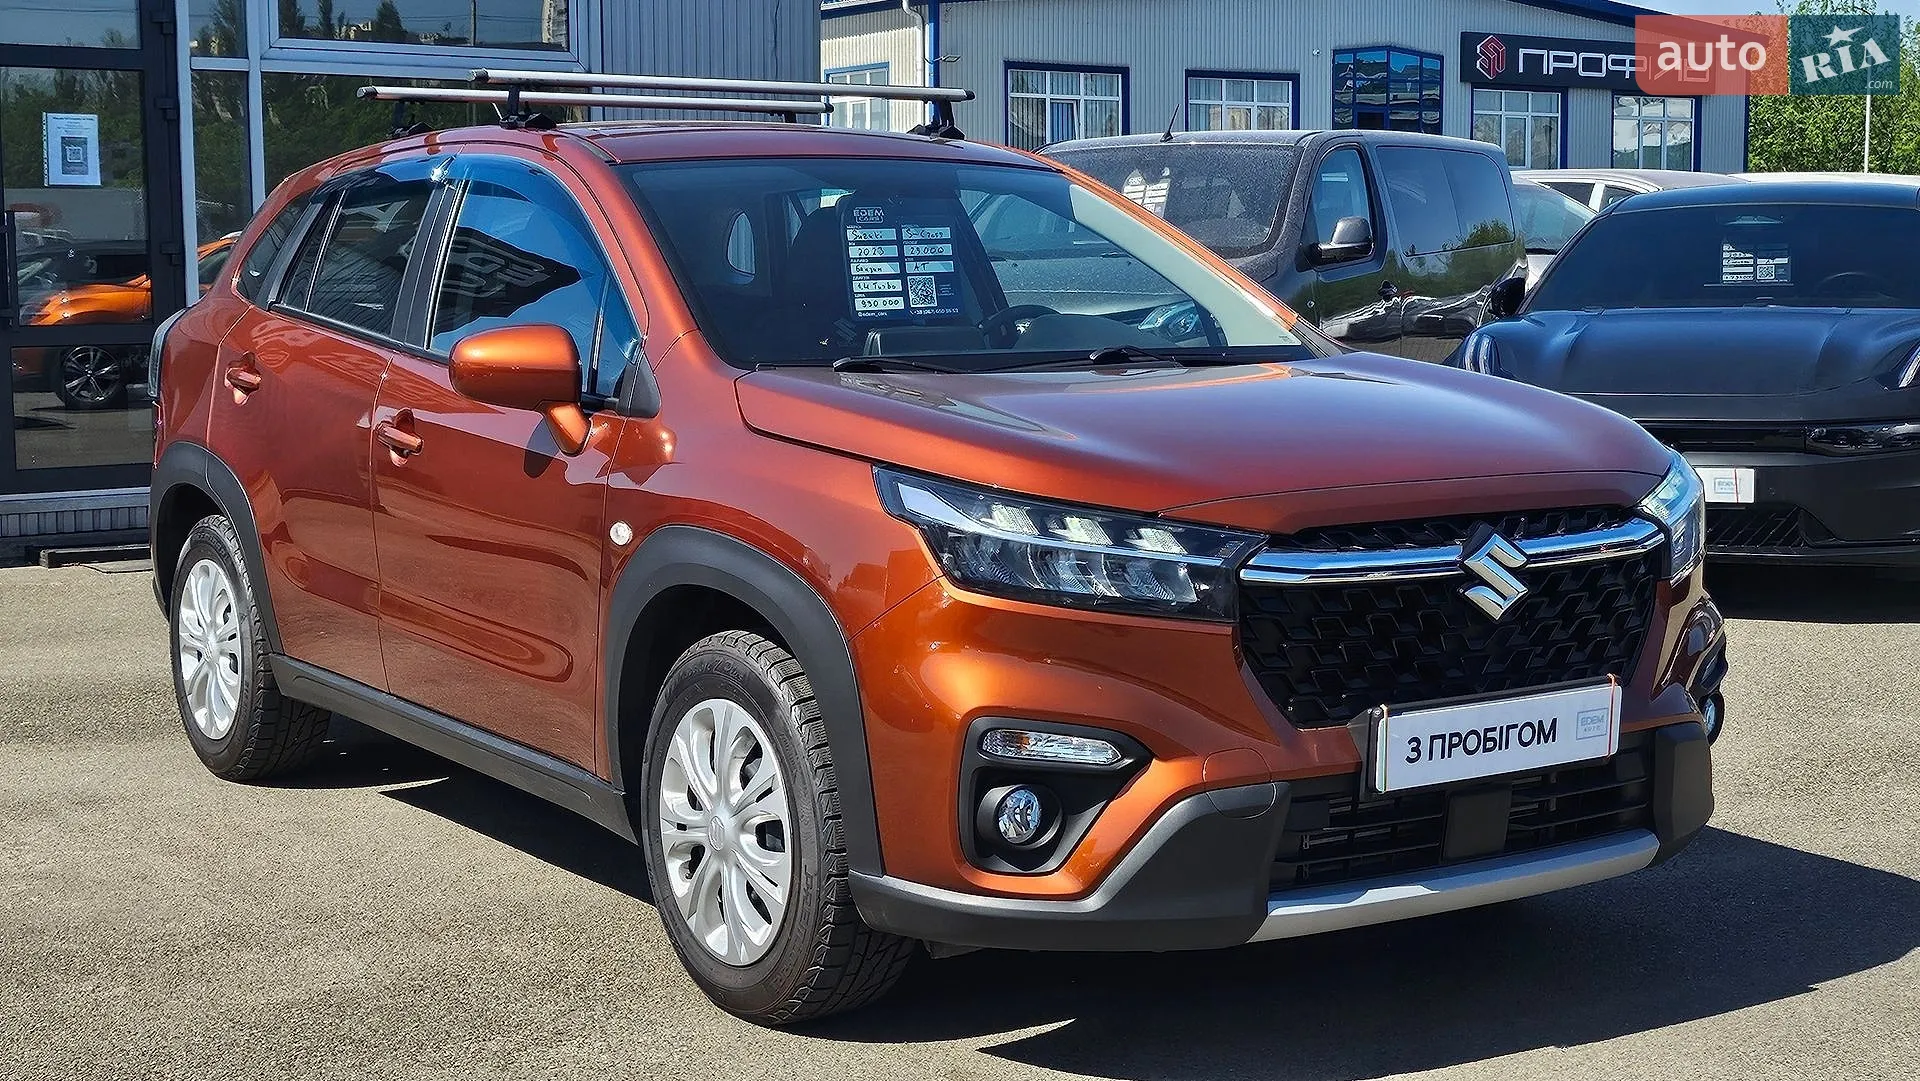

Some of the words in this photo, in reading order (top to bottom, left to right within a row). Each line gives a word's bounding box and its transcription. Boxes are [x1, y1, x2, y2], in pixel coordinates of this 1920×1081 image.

[858, 246, 884, 256] 2023
[1405, 737, 1422, 764] З
[1428, 717, 1558, 761] ПРОБІГОМ
